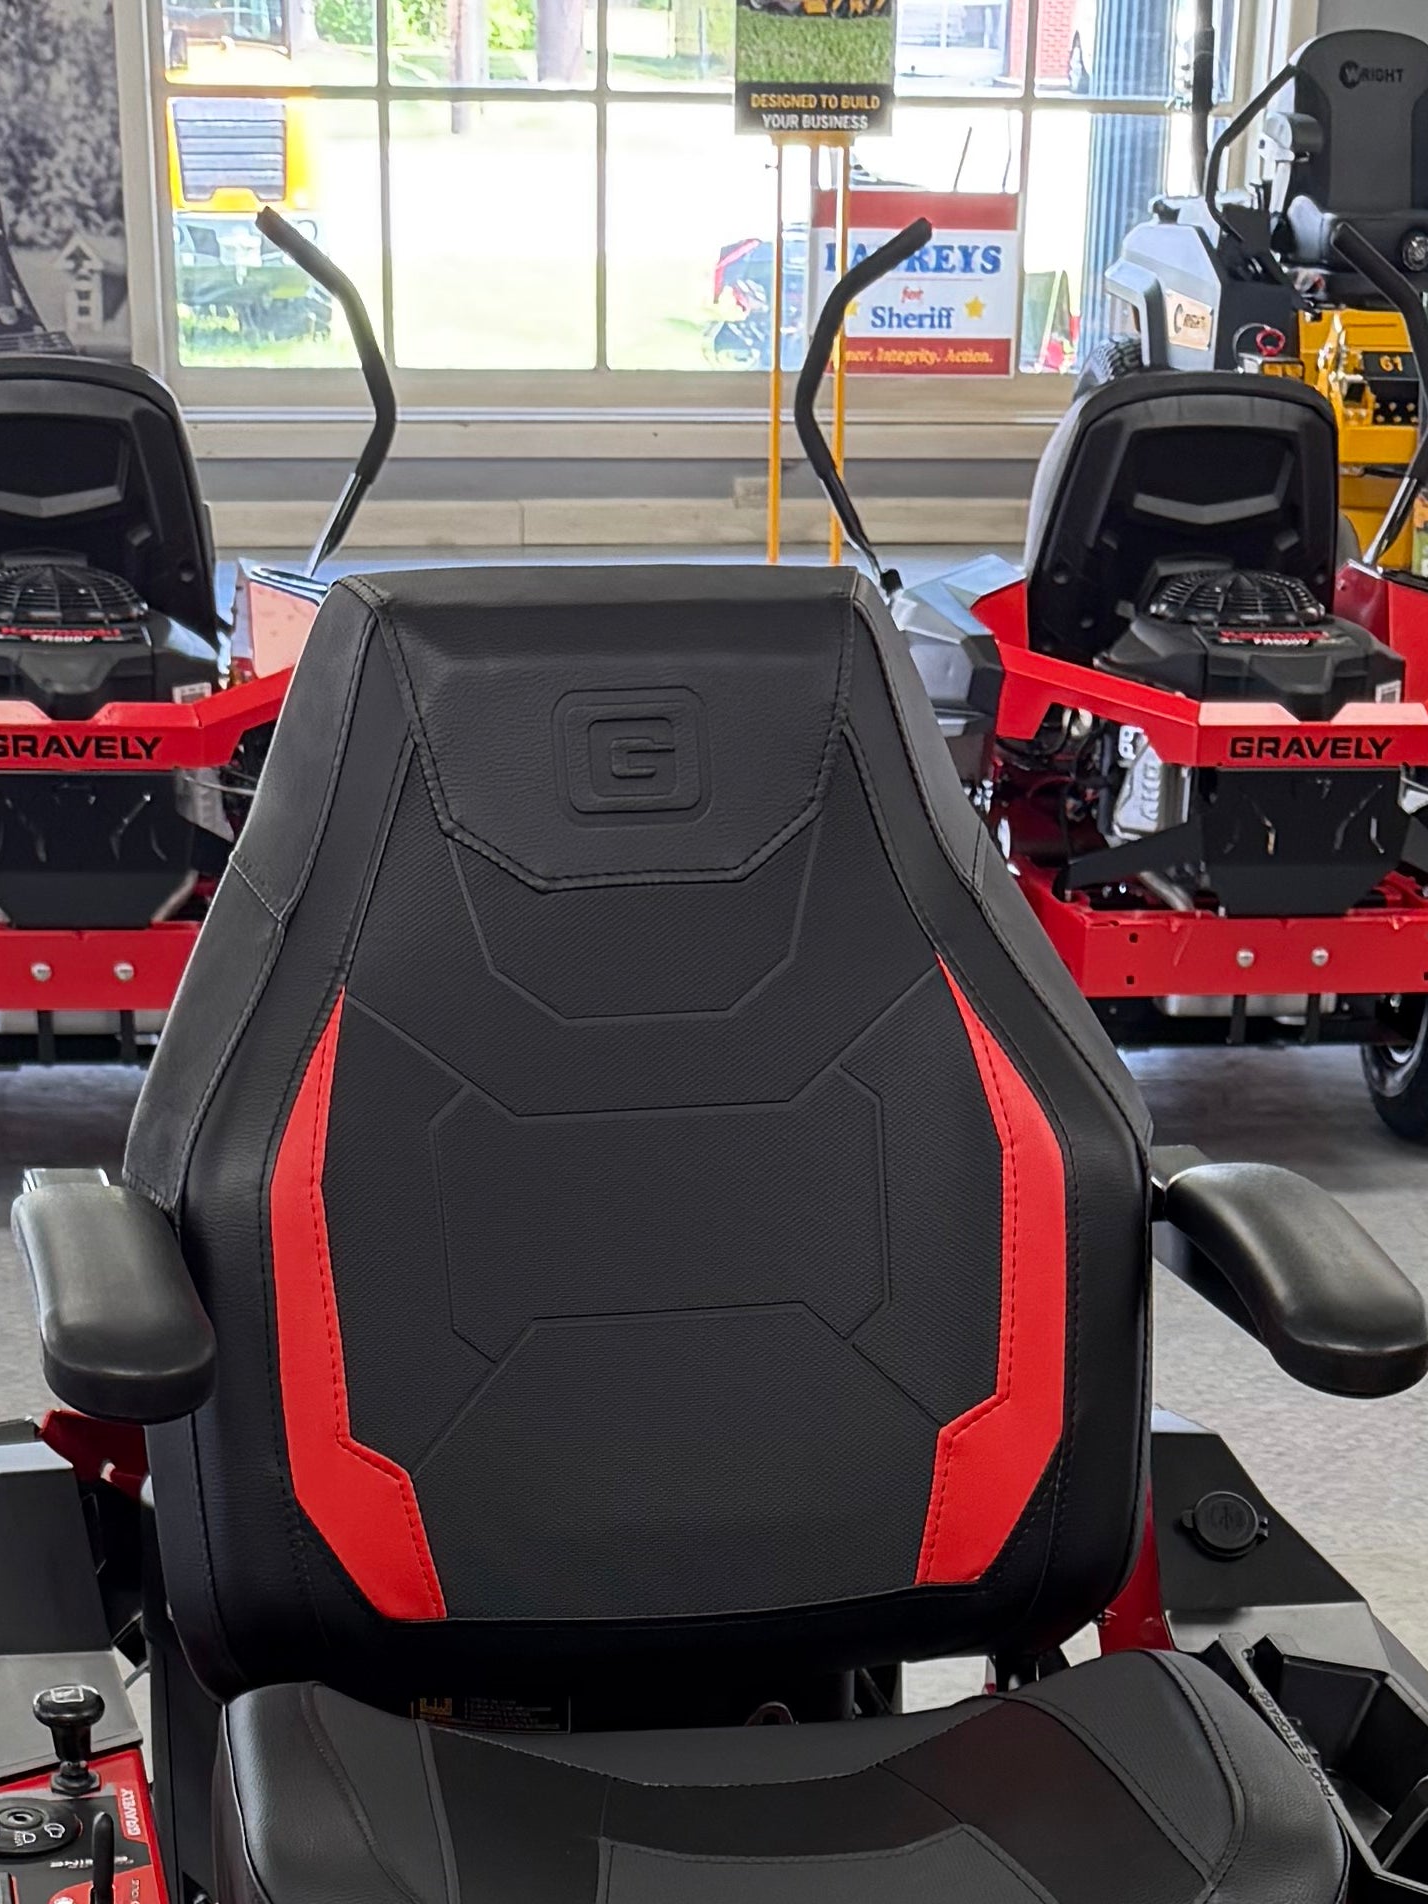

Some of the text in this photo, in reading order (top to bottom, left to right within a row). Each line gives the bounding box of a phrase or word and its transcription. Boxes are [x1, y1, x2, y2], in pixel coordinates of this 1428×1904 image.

[751, 93, 881, 109] DESIGNED TO BUILD
[762, 113, 869, 129] YOUR BUSINESS
[871, 306, 955, 329] Sheriff
[1229, 736, 1394, 760] GRAVELY
